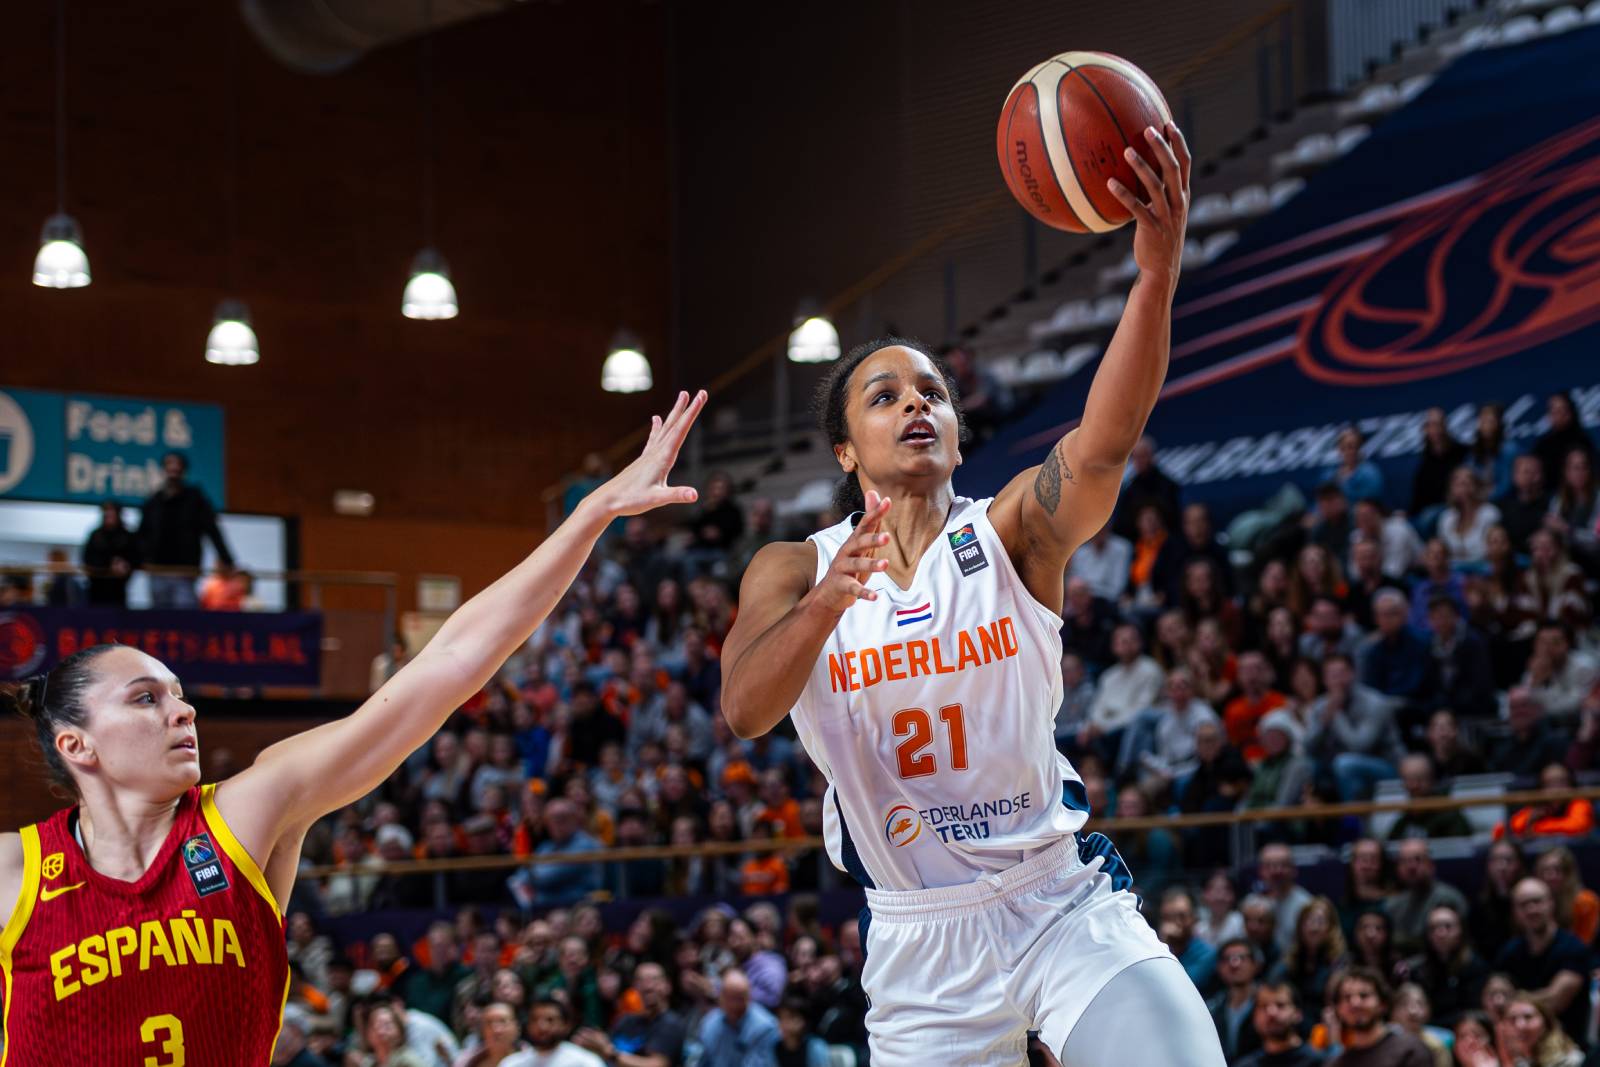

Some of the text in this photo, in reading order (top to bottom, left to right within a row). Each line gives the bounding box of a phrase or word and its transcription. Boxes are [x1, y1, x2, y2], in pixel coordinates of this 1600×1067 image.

[1016, 139, 1051, 214] molten
[66, 401, 192, 448] Food &
[958, 545, 979, 562] FIBA
[828, 616, 1019, 693] NEDERLAND
[892, 702, 968, 779] 21
[919, 792, 1031, 825] EDERLANDSE
[935, 821, 990, 843] TERIJ
[195, 865, 219, 882] FIBA
[50, 909, 246, 1002] ESPAÑA
[140, 1013, 186, 1067] 3
